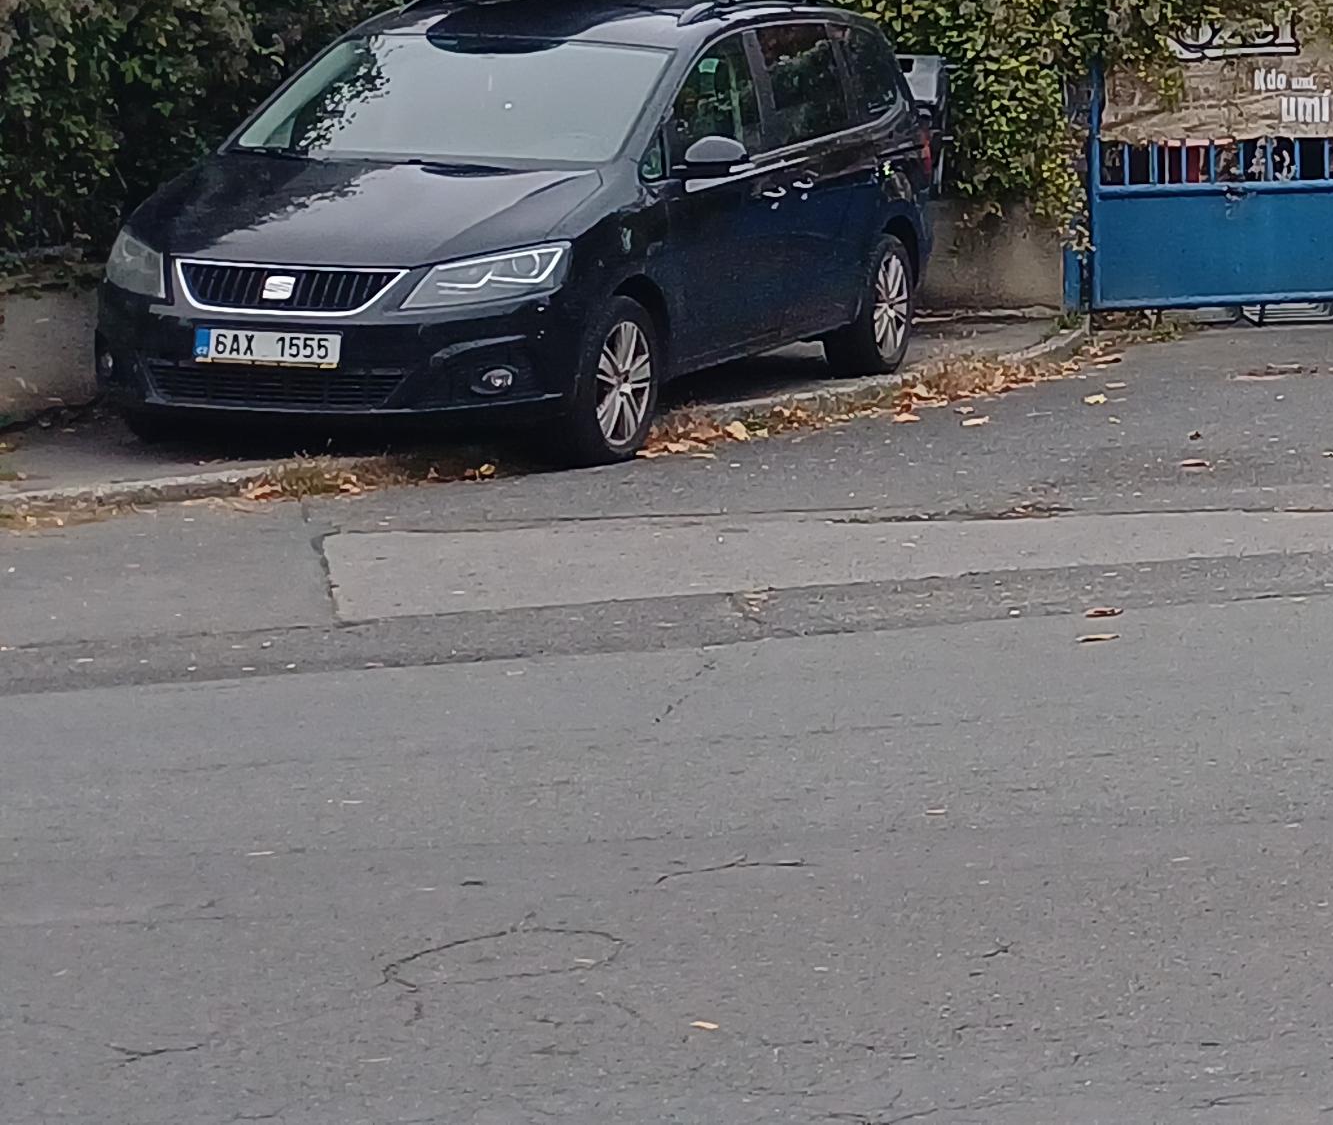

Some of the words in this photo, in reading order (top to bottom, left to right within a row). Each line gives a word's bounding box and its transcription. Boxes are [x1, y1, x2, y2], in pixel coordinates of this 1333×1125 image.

[1253, 67, 1288, 91] Kdo
[1281, 88, 1332, 123] umí
[214, 332, 255, 357] 6AX
[276, 336, 329, 360] 1555
